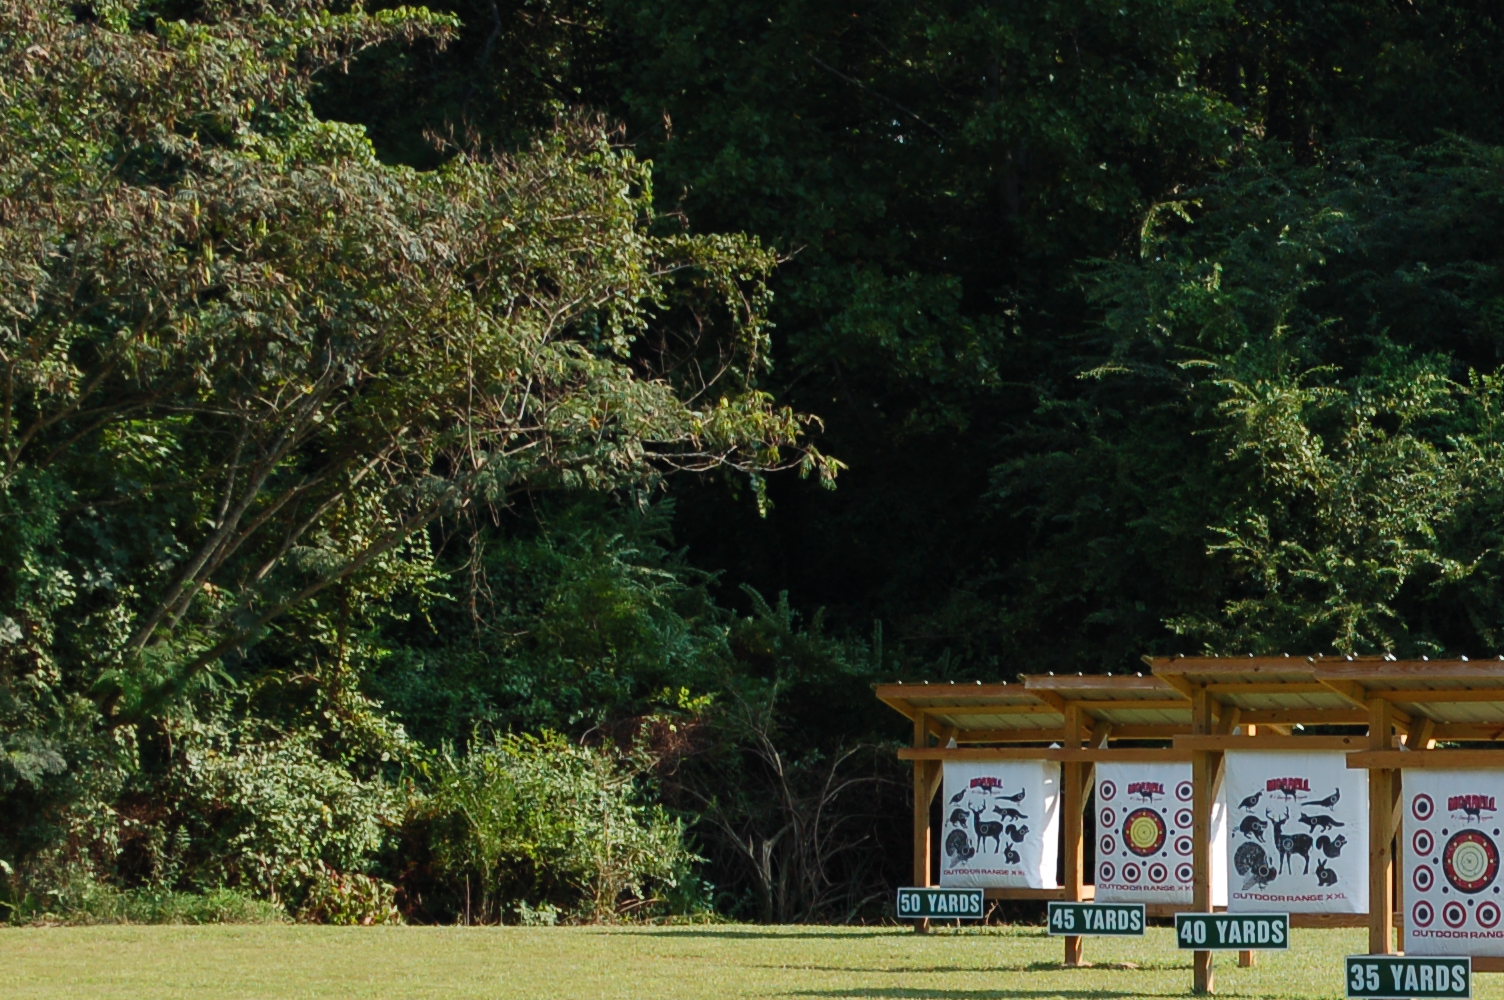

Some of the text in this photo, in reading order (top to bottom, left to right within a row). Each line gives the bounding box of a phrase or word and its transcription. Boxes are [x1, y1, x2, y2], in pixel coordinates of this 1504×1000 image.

[1448, 794, 1498, 812] MORRELL
[900, 893, 980, 914] 50 YARDS
[1052, 908, 1142, 931] 45 YARDS
[1180, 919, 1284, 944] 40 YARDS
[1412, 930, 1468, 938] OUTDOOR
[1350, 962, 1466, 992] 35 YARDS
